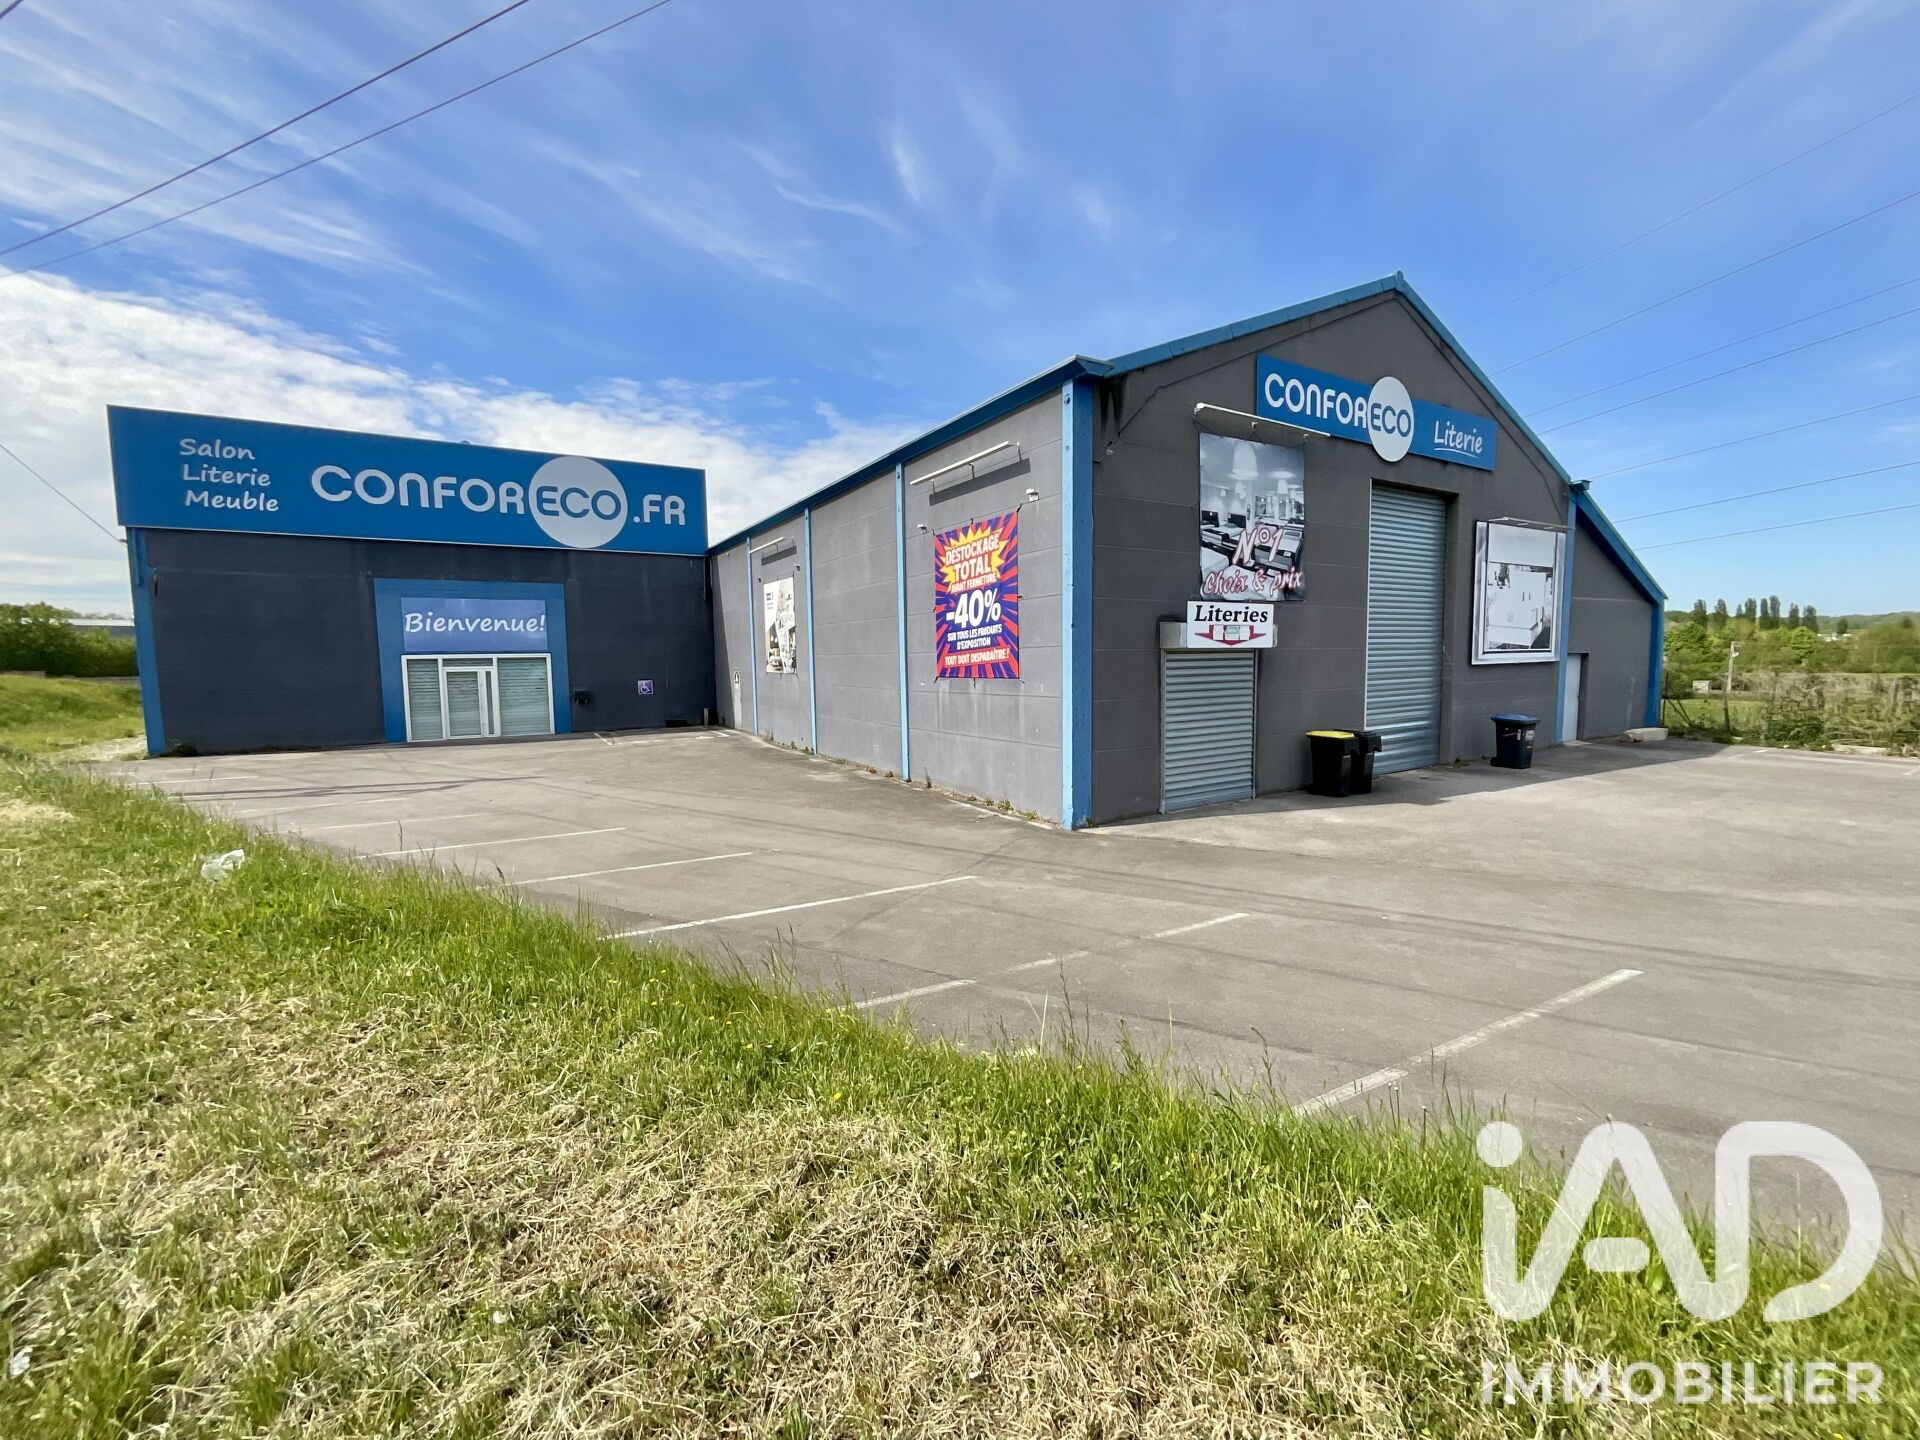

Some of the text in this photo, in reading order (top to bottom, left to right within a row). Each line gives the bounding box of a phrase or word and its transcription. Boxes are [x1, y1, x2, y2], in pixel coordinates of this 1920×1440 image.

[1434, 420, 1483, 455] Literie
[179, 438, 256, 461] Salon
[182, 464, 272, 488] Literie
[184, 490, 281, 513] Meuble
[953, 554, 992, 582] TOTAL
[1201, 566, 1303, 597] Choix & prix
[946, 588, 1001, 629] -40%
[1194, 604, 1268, 622] Literies
[405, 611, 546, 634] Bienvenue!
[957, 630, 969, 640] TOUS
[969, 628, 978, 638] LES
[978, 624, 1003, 637] PRODUITS
[945, 656, 957, 666] TOUT
[957, 654, 970, 664] DOIT
